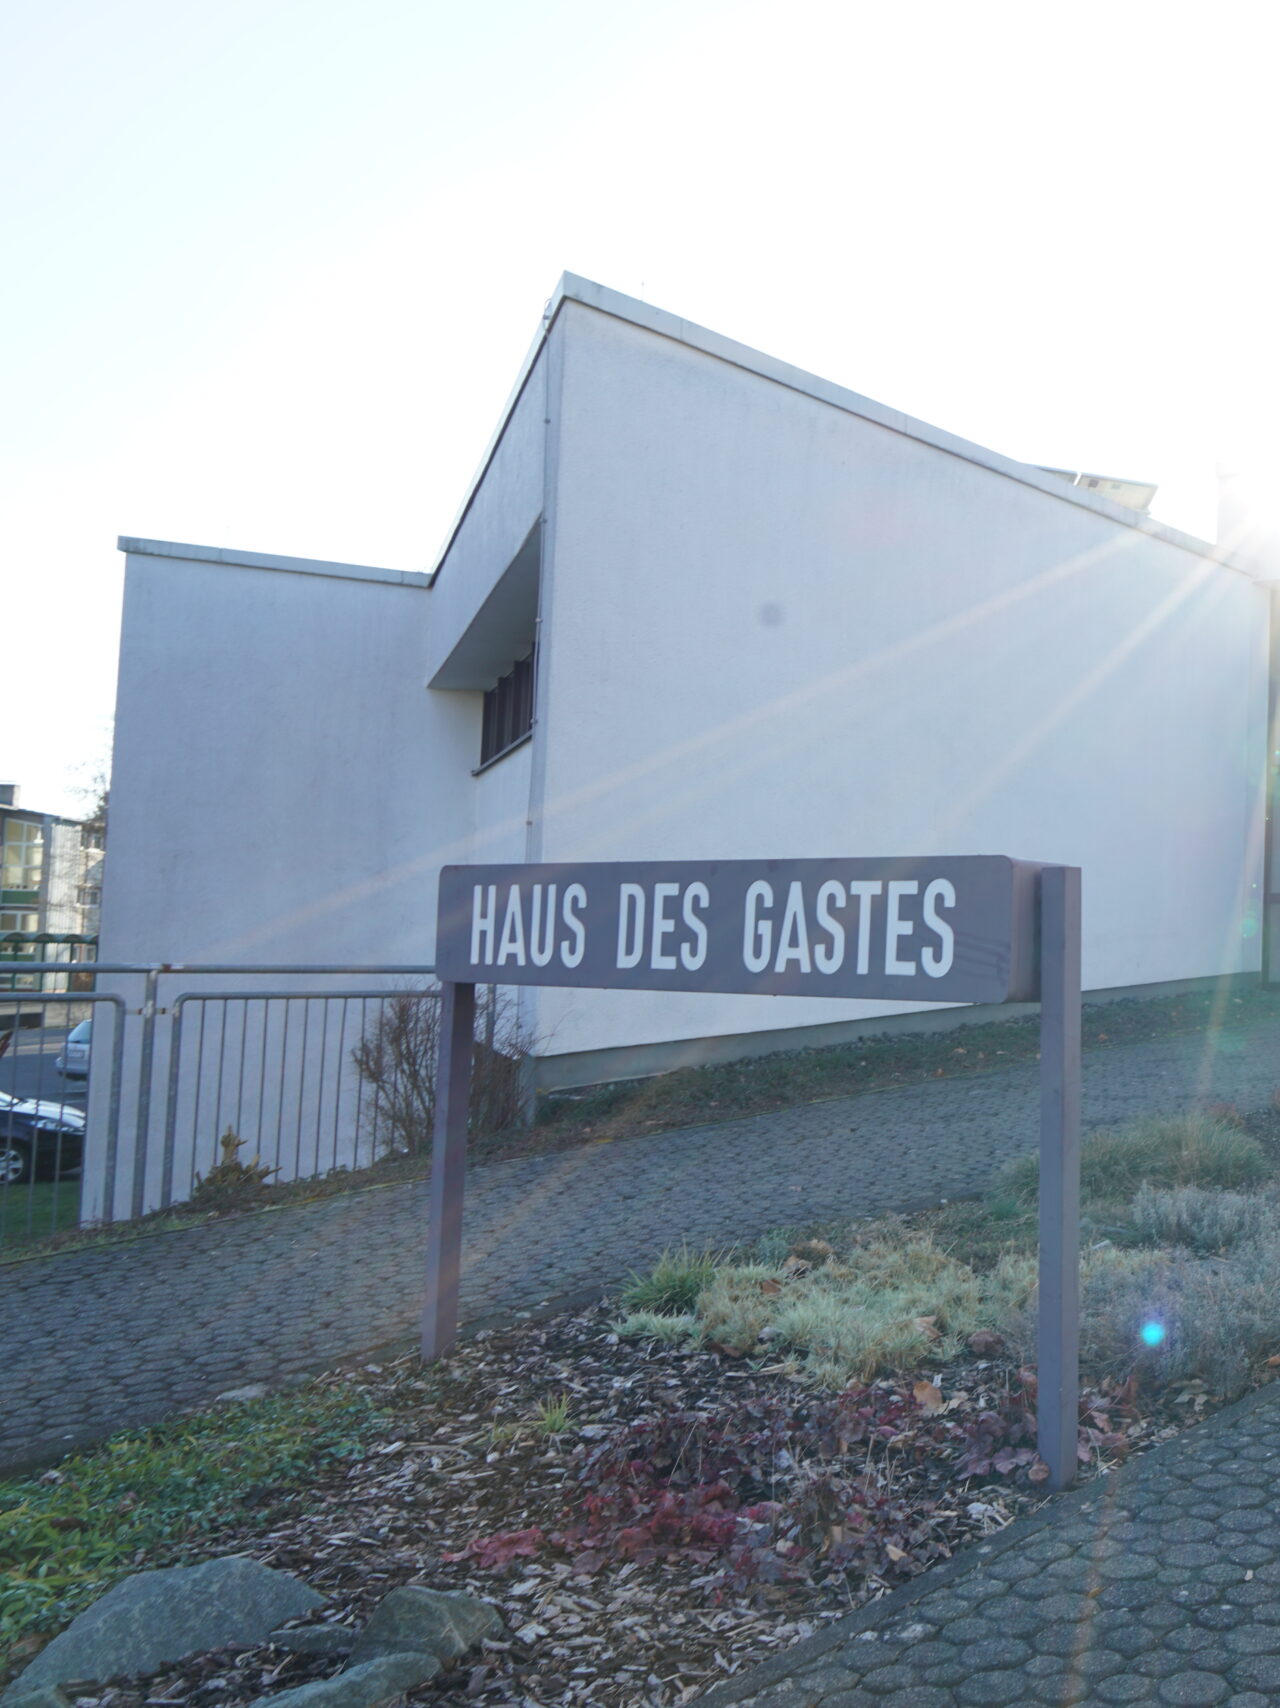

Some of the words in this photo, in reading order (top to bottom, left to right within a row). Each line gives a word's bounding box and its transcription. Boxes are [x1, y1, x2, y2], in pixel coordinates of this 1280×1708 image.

[469, 883, 587, 968] HAUS
[616, 881, 710, 972] DES
[743, 878, 955, 978] GASTES
